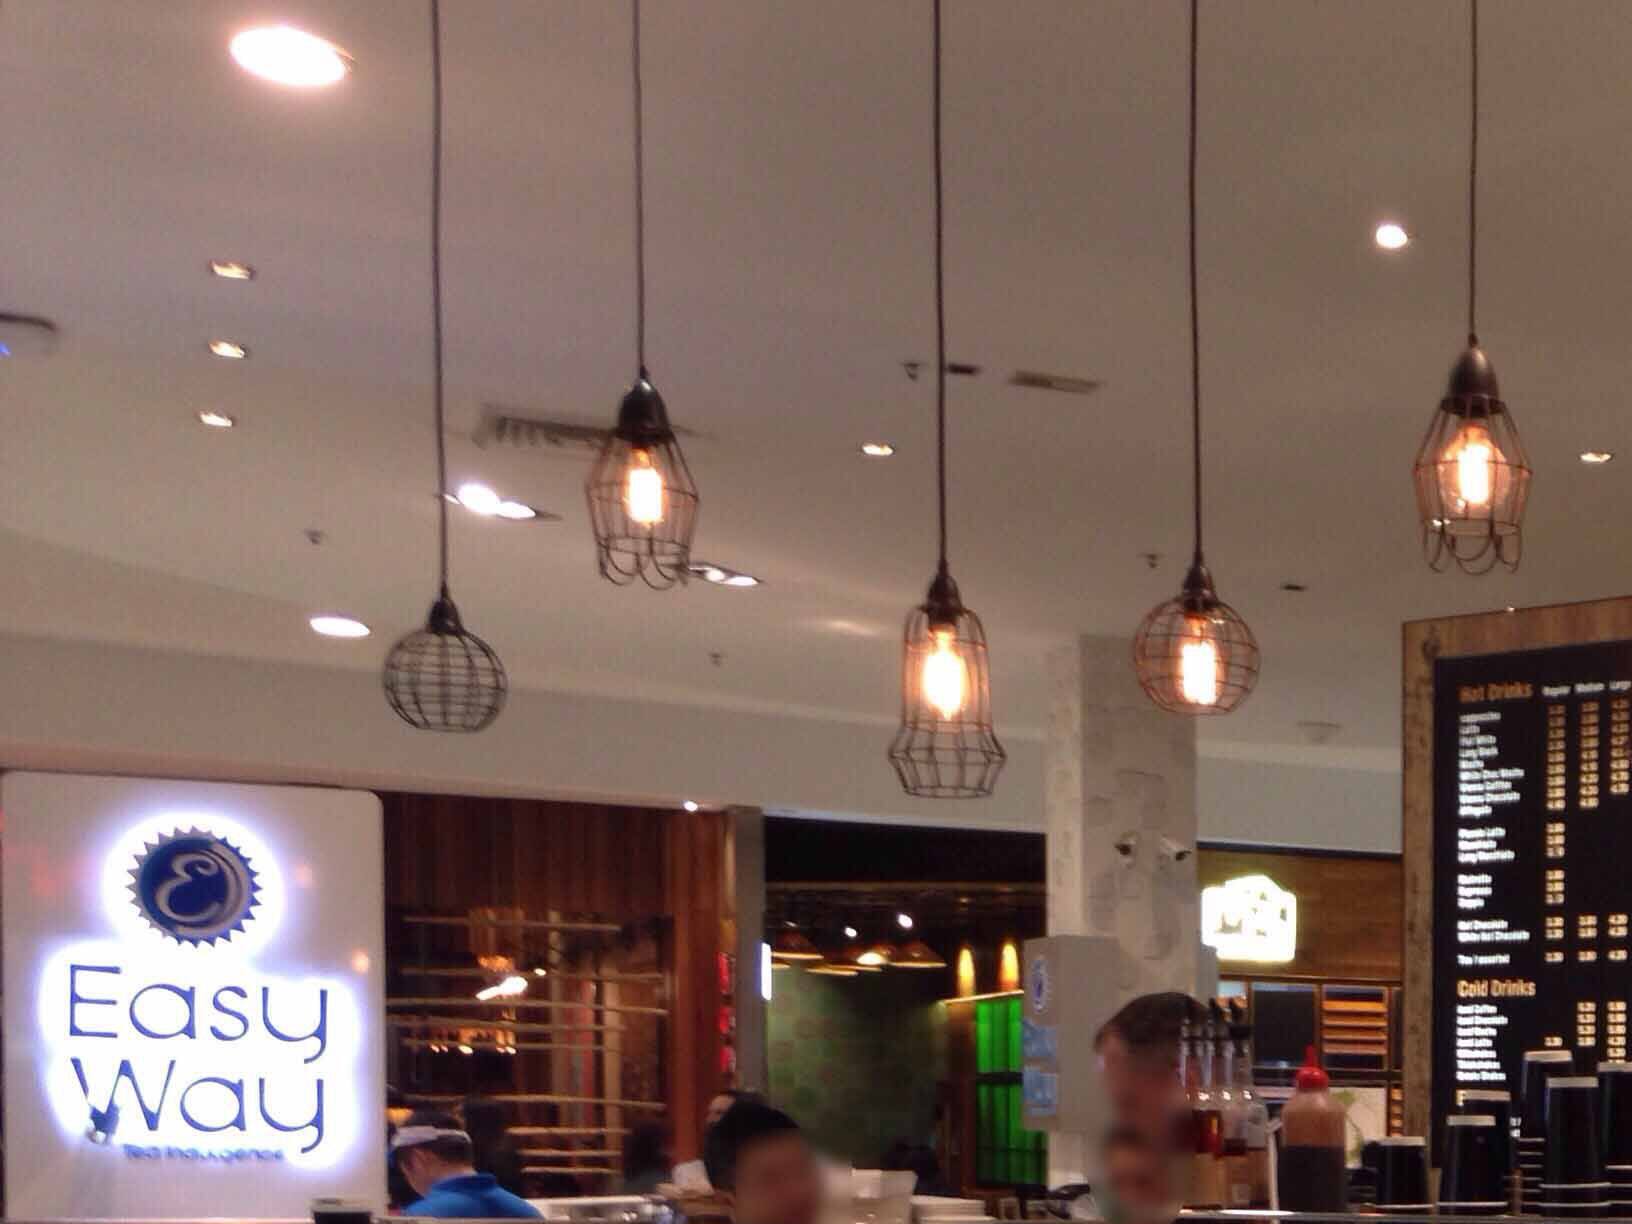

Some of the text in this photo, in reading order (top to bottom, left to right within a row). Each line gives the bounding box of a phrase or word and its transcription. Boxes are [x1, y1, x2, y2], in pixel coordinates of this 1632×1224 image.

[69, 964, 328, 1064] Easy
[1457, 979, 1536, 998] Cold Drinks
[70, 1057, 324, 1153] Way
